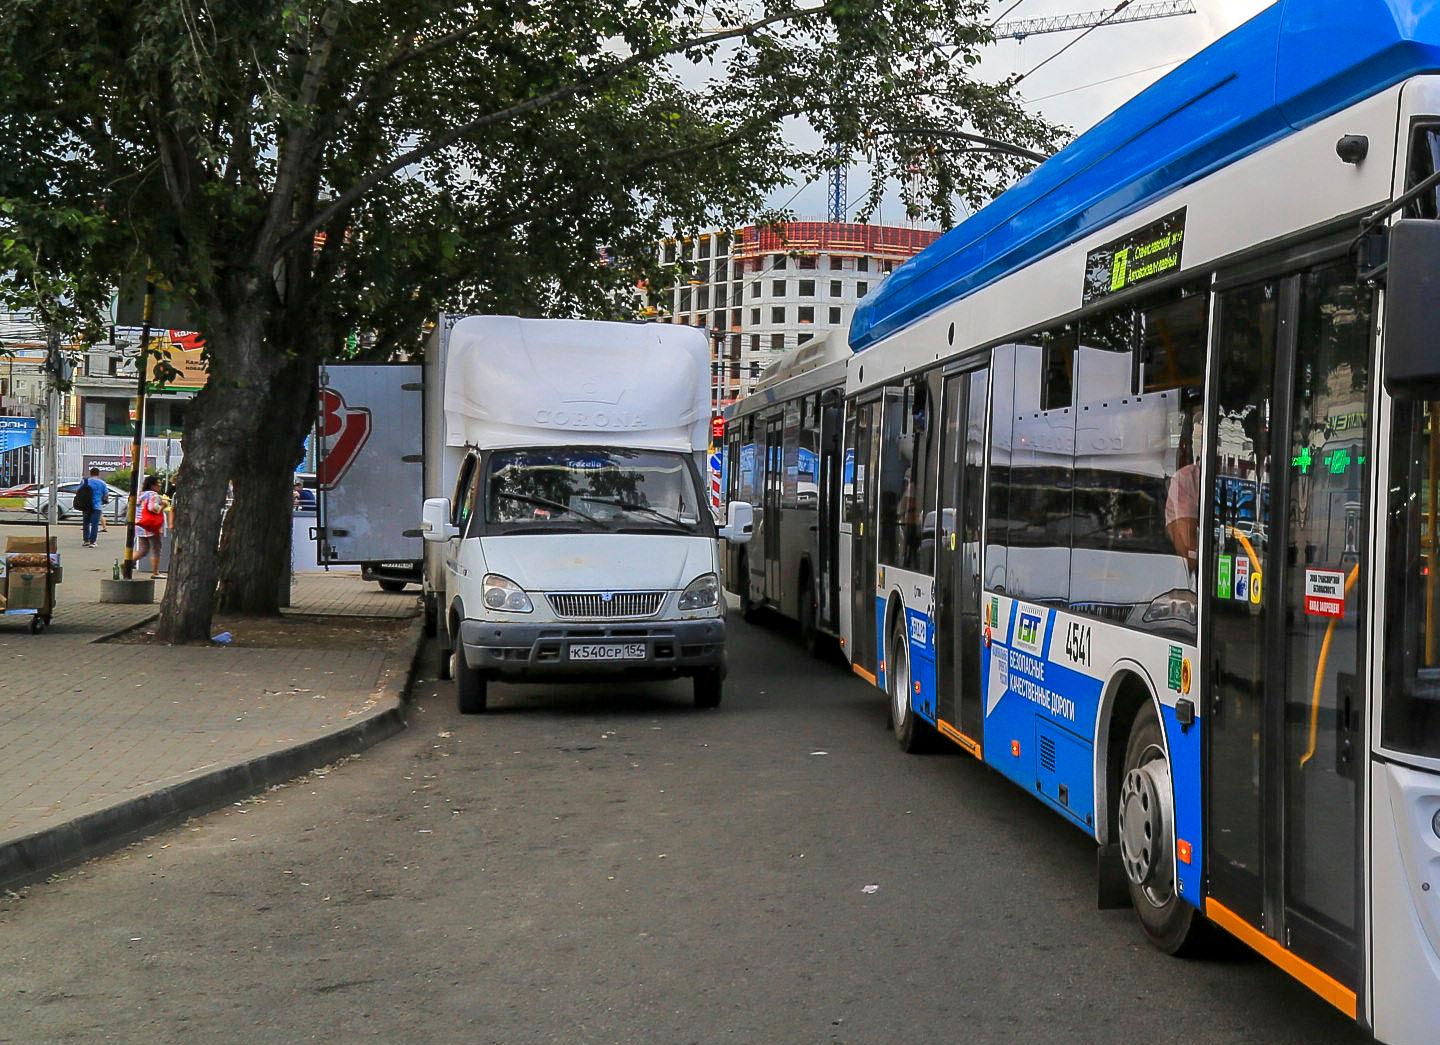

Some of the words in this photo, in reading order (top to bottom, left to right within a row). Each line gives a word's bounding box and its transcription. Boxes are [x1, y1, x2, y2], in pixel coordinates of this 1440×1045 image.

[535, 411, 647, 428] CORONA
[573, 646, 622, 658] К540СР
[624, 644, 645, 657] 154
[1065, 622, 1092, 668] 4541
[1009, 650, 1045, 681] БЕЗОПАСНЫЕ
[1009, 673, 1051, 710] КАЧЕСТВЕННЫЕ
[1051, 692, 1075, 722] ДОРОГИ
